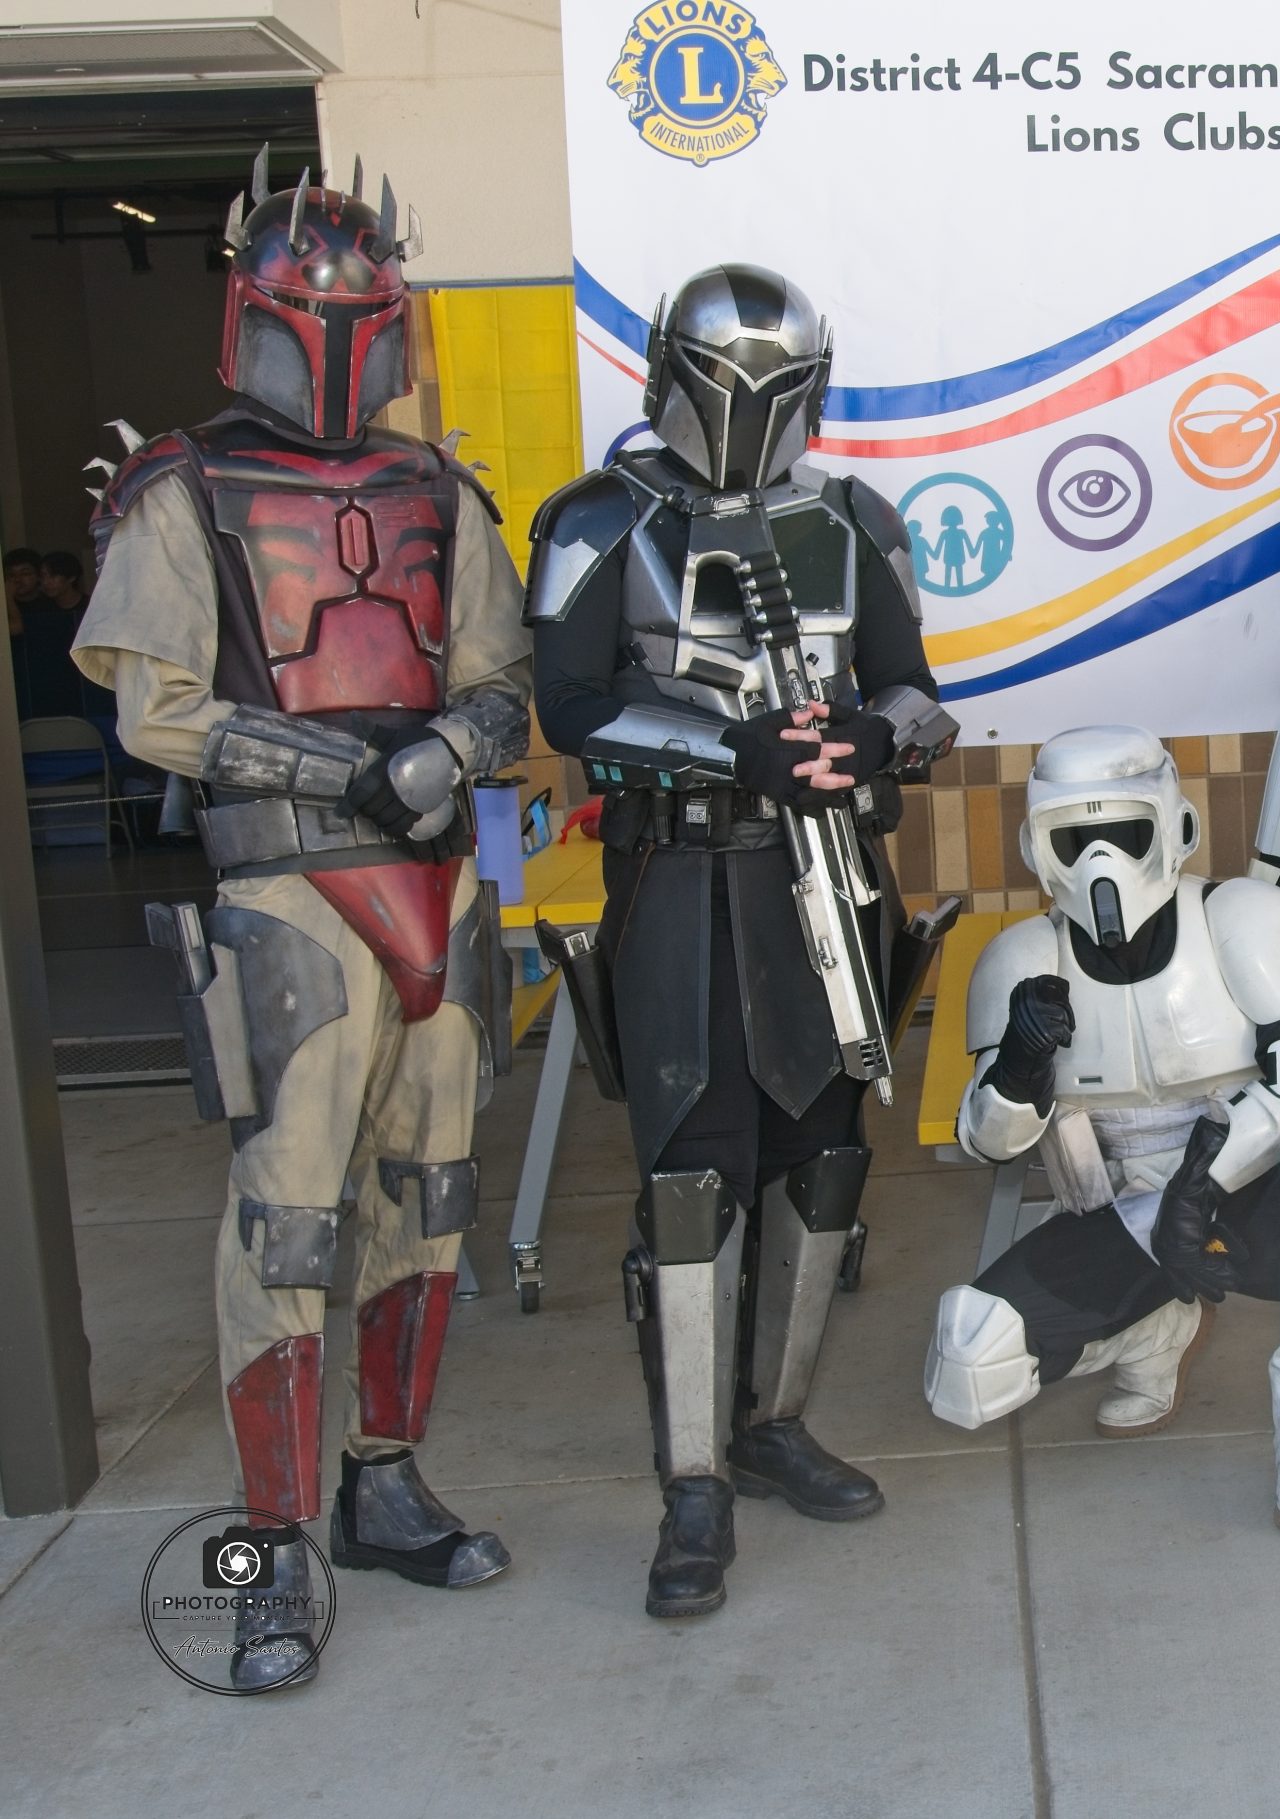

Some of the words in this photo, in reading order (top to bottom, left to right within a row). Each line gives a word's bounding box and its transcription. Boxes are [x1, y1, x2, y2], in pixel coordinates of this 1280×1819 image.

[644, 0, 746, 35] LIONS
[678, 47, 724, 104] L
[803, 52, 962, 92] District
[972, 51, 1082, 91] 4-C5
[650, 121, 750, 152] INTERNATIONAL
[1026, 114, 1140, 153] Lions
